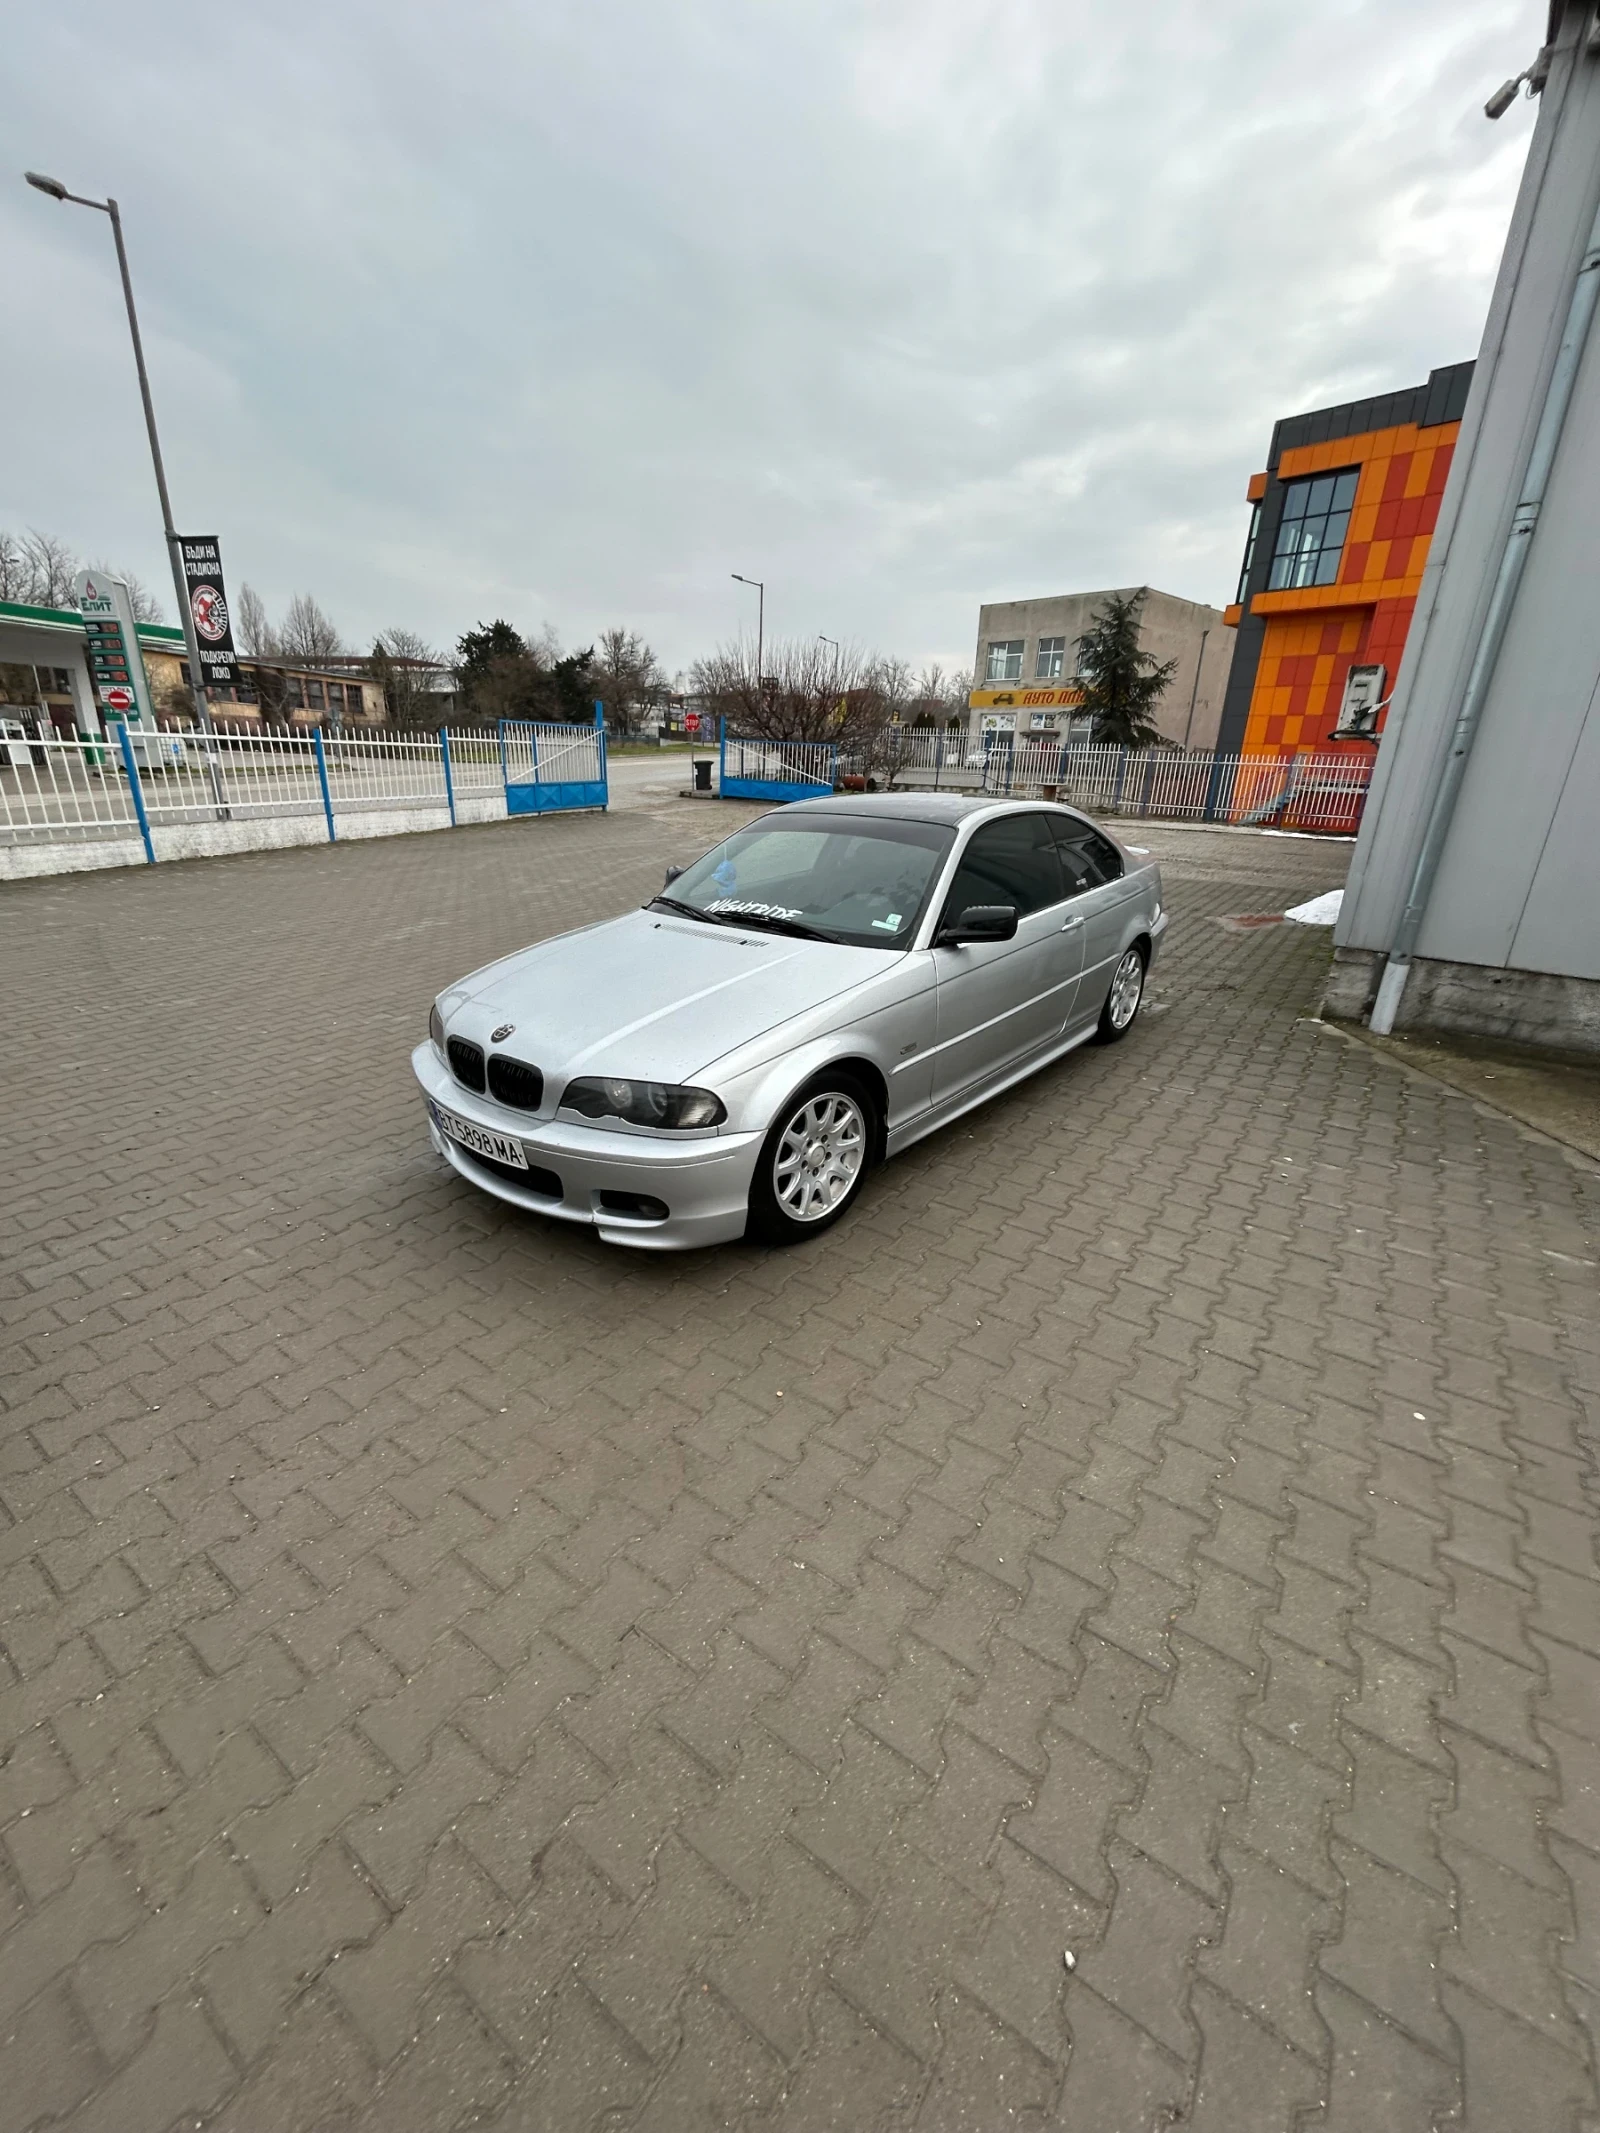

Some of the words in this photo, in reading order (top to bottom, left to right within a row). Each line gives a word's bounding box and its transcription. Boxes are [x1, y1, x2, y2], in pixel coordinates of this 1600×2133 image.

[185, 546, 205, 559] БЪДИ
[206, 545, 216, 558] НА
[186, 562, 221, 576] СТАДИОНА
[200, 651, 236, 663] ПОДКРЕПИ
[212, 666, 231, 679] ЛОКО
[1023, 692, 1054, 704] АУТО
[455, 1120, 493, 1154] 5898
[493, 1137, 521, 1164] MA
